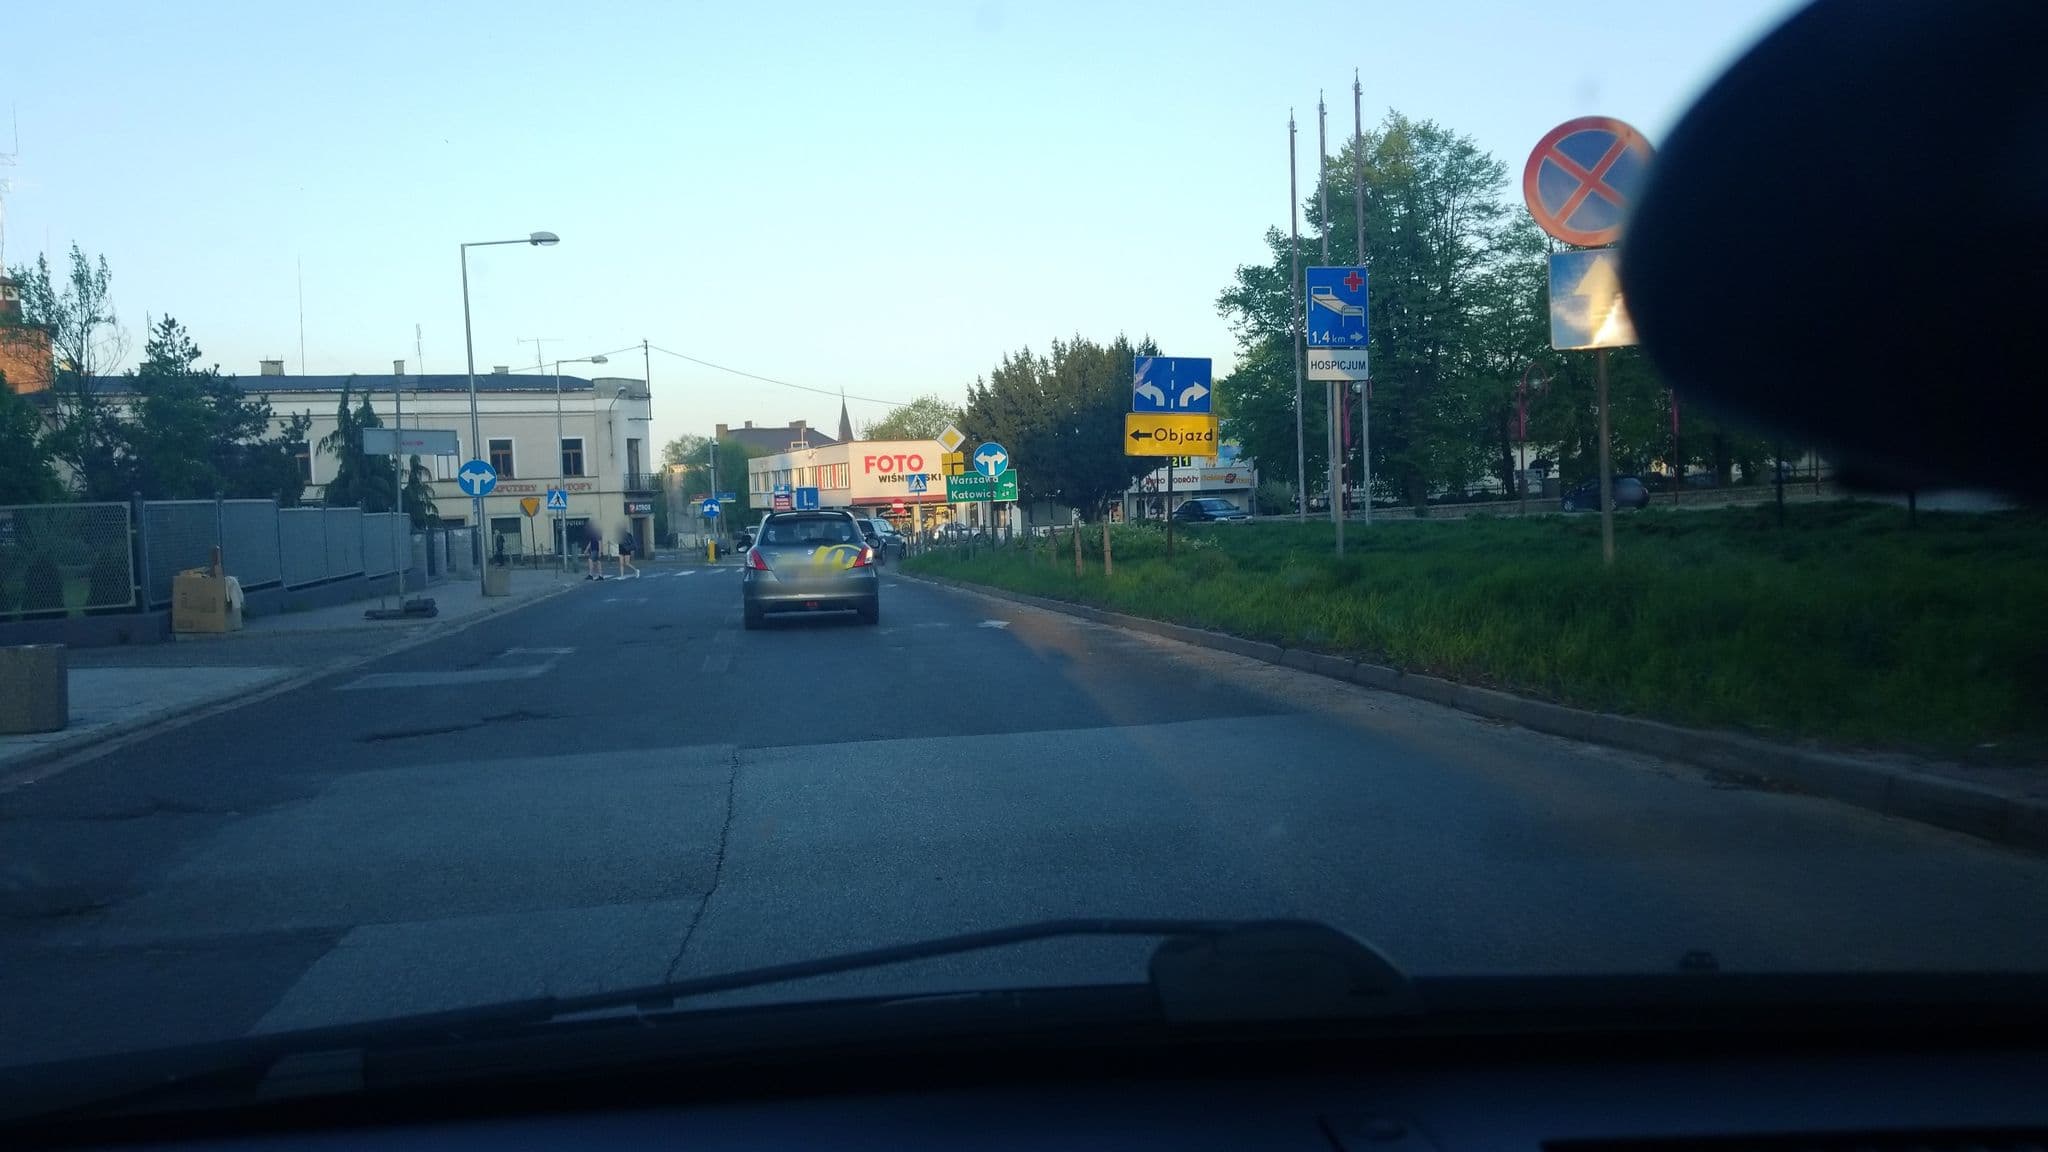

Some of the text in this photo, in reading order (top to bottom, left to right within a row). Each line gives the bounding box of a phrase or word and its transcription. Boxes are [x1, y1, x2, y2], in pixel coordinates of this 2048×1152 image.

[1312, 331, 1346, 345] 1,4 km
[1310, 360, 1367, 370] HOSPICJUM
[1154, 428, 1213, 445] Objazd
[864, 454, 924, 474] FOTO
